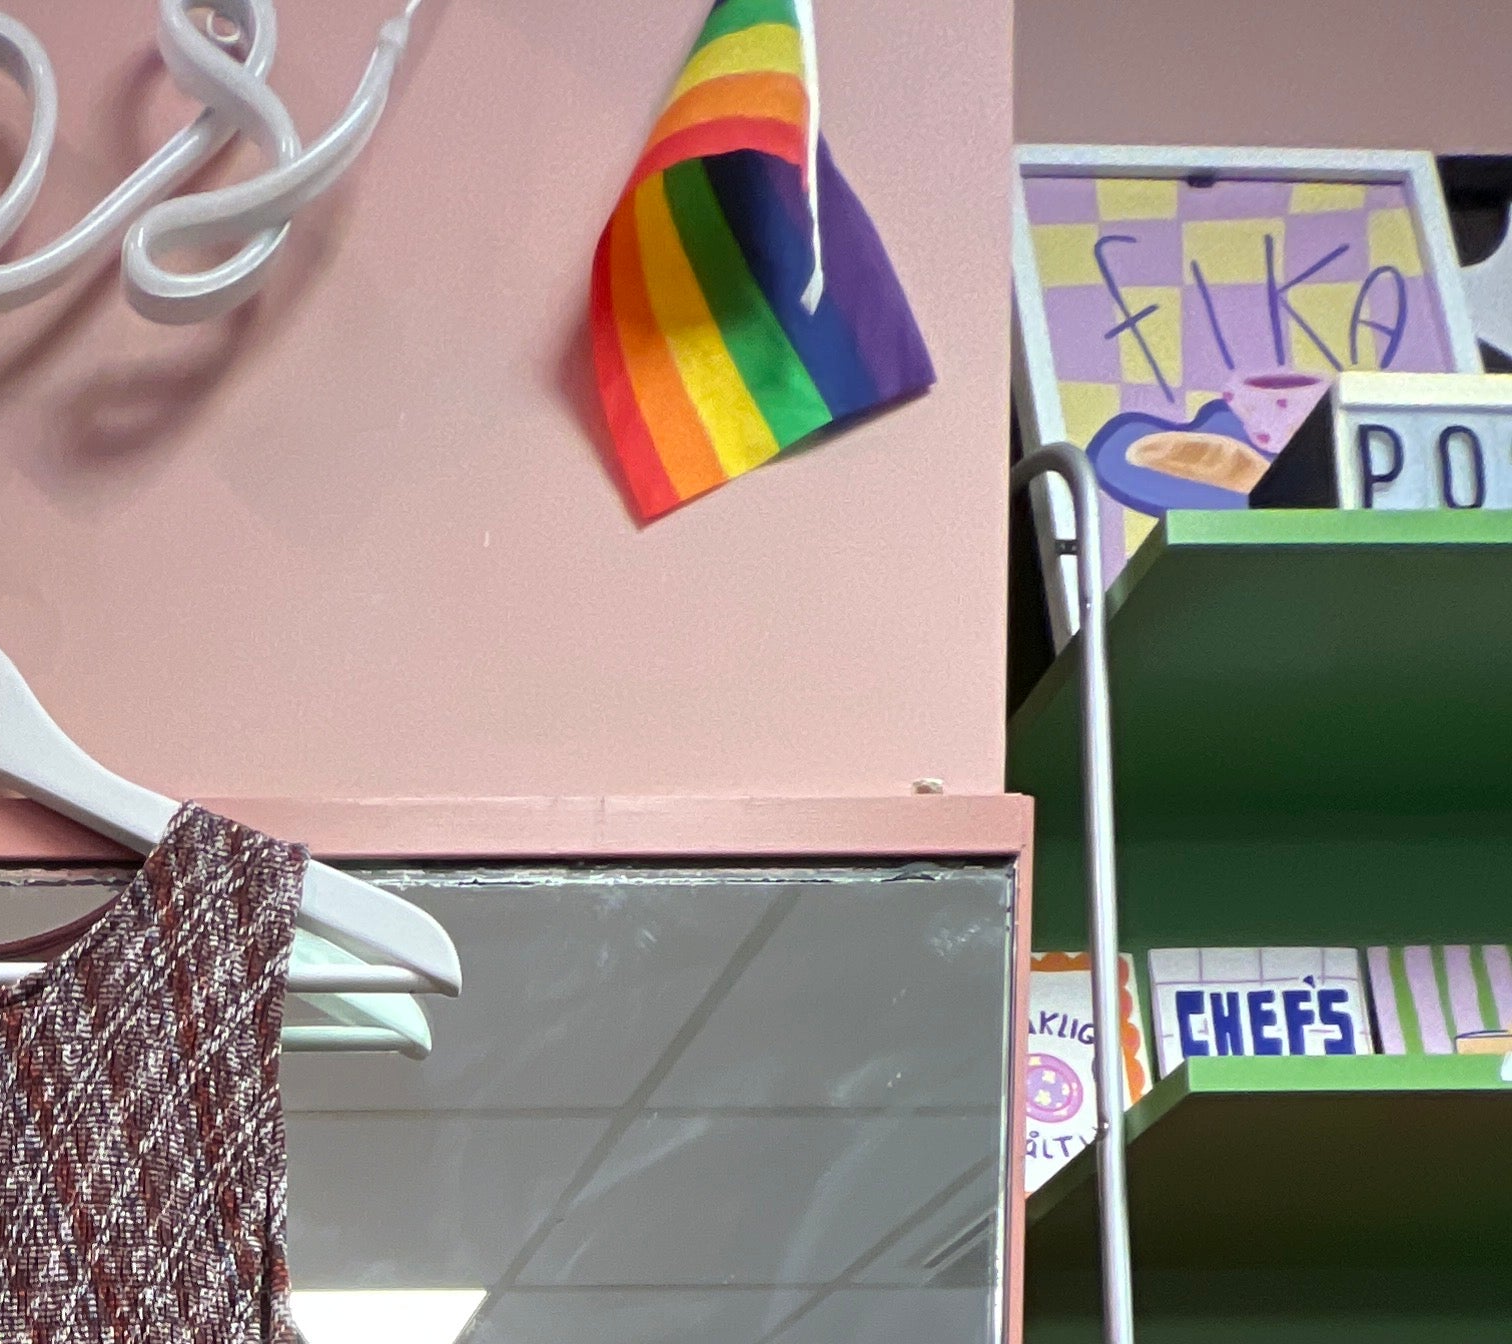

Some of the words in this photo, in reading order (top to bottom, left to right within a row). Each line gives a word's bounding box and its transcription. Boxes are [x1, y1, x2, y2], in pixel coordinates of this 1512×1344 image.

[1093, 233, 1409, 404] FIKA
[1357, 424, 1486, 509] PO
[1175, 975, 1356, 1056] CHEF'S
